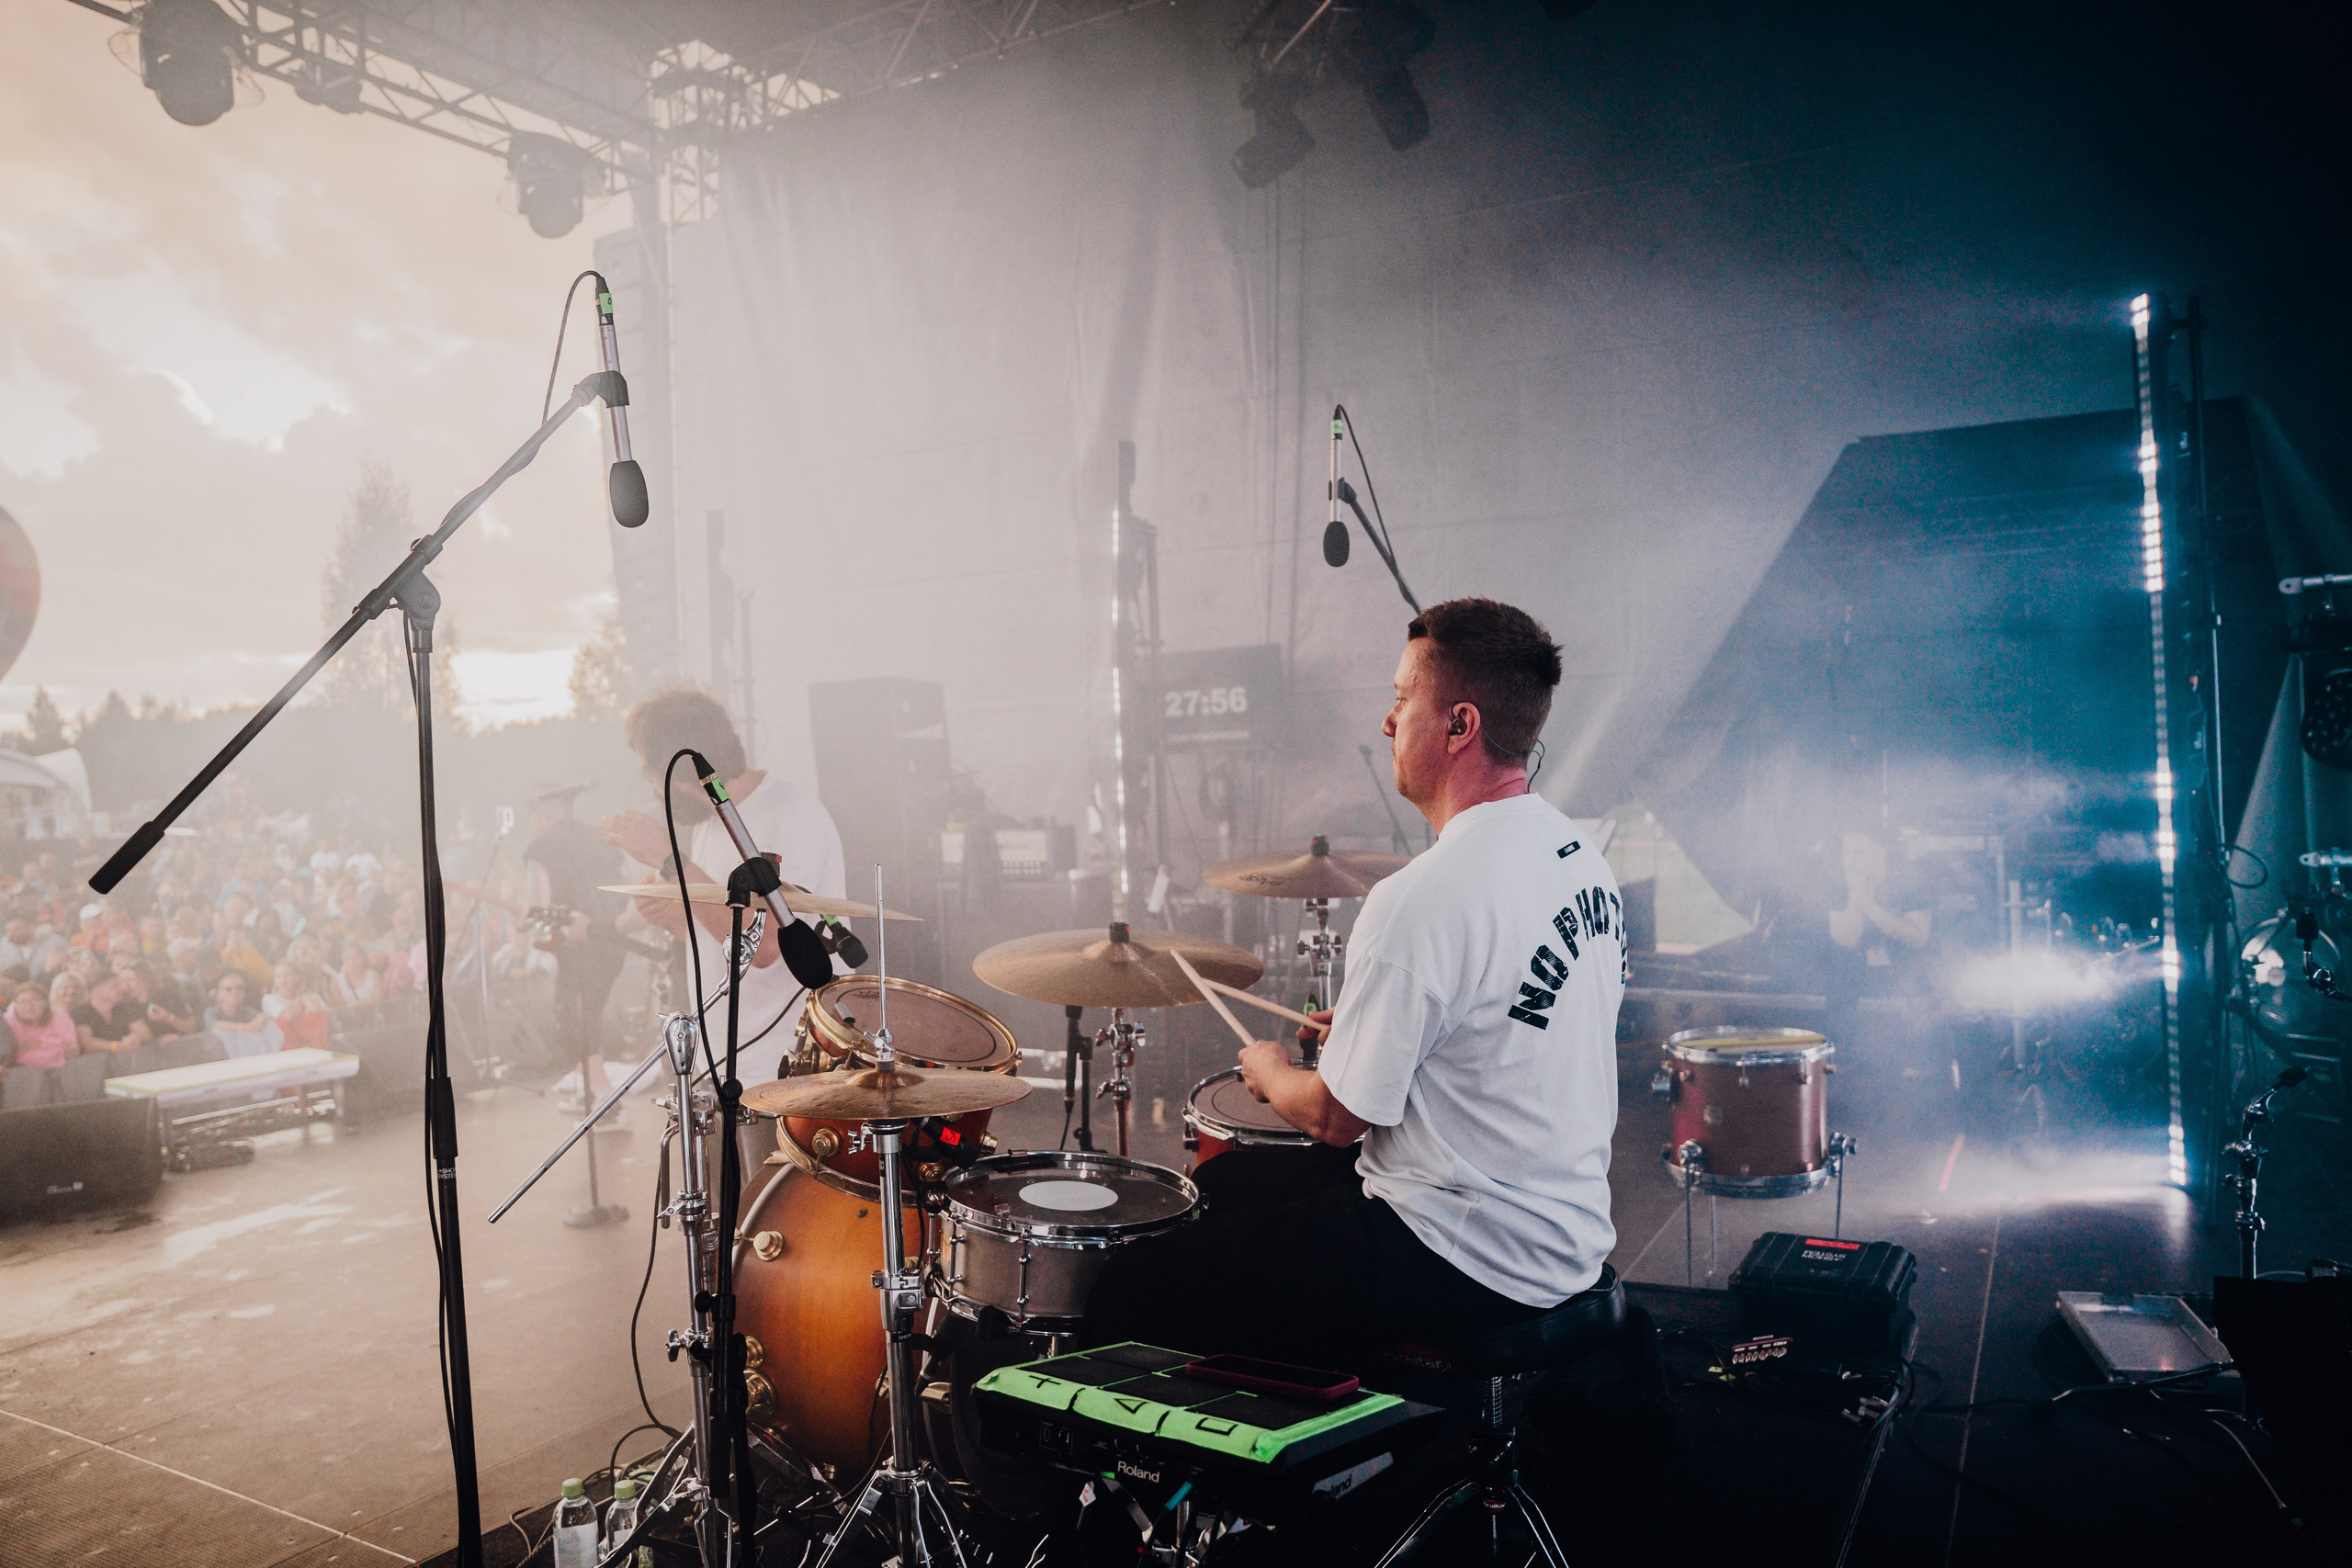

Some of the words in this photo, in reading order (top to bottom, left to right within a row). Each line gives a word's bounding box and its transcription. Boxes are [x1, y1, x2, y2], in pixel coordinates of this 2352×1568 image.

[1164, 686, 1249, 717] 27:56
[1507, 943, 1569, 1031] NO
[1552, 886, 1628, 985] PHOT
[1117, 1460, 1160, 1483] Roland
[1329, 1472, 1352, 1496] land
